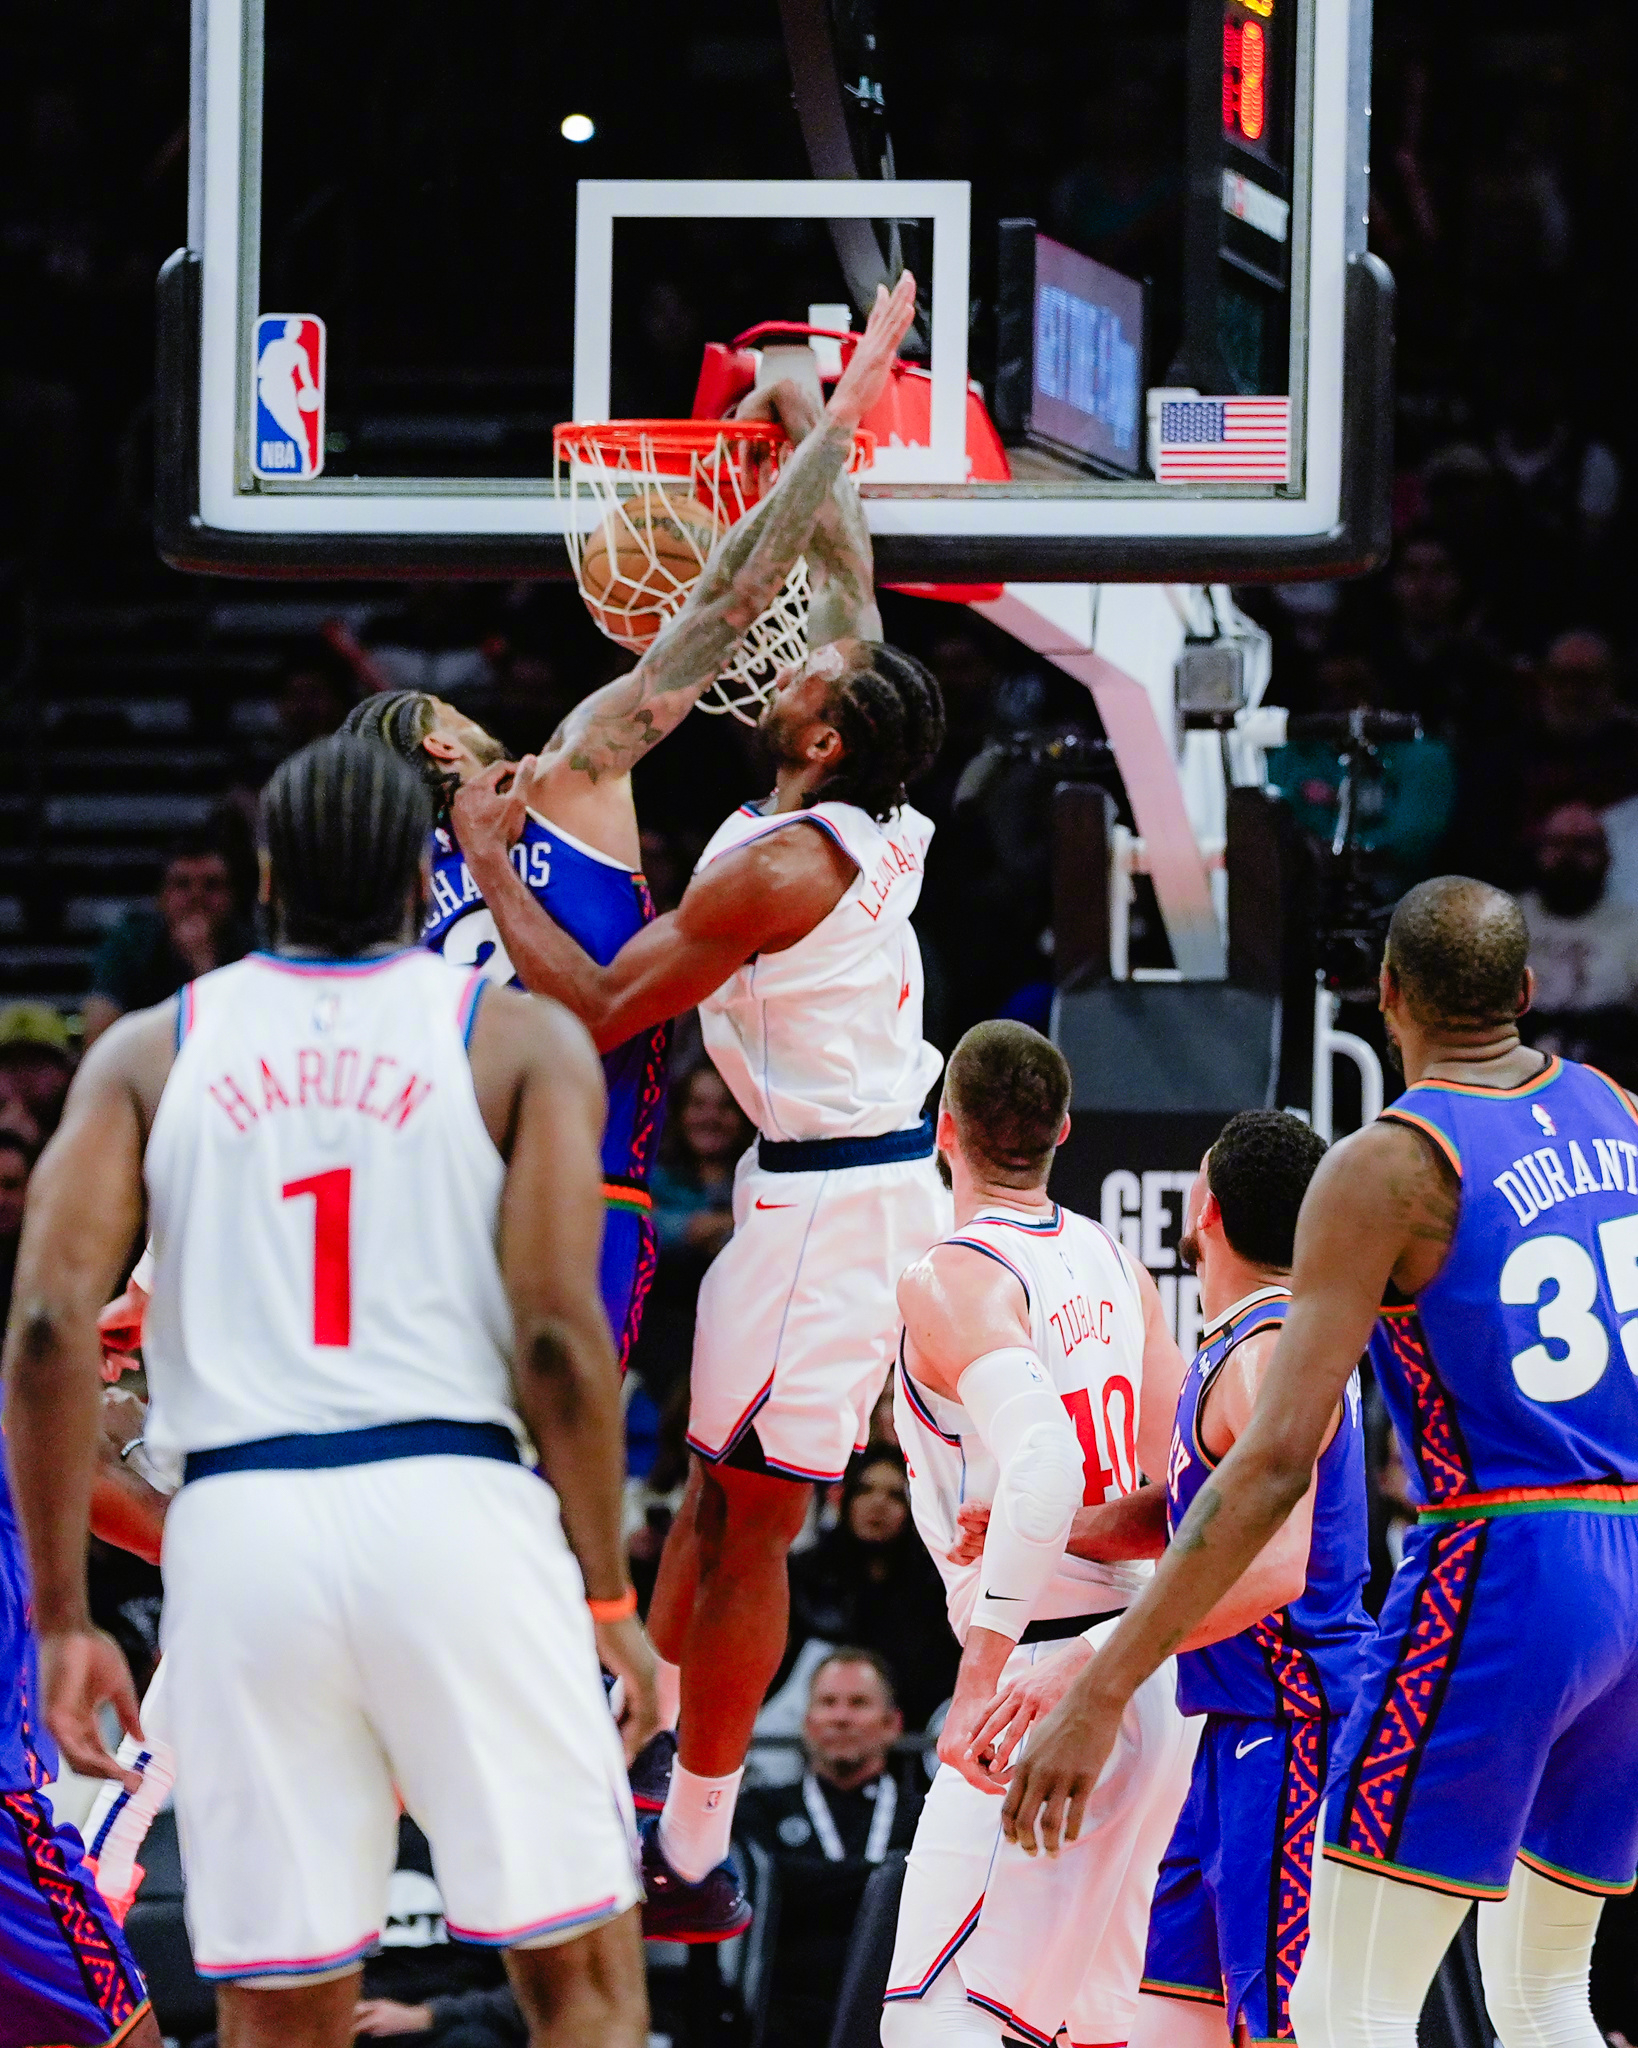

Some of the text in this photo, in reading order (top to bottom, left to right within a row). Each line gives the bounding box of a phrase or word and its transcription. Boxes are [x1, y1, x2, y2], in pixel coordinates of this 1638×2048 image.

[260, 439, 296, 469] NBA
[209, 1047, 433, 1133] HARDEN
[1493, 1138, 1638, 1227] DURANT
[281, 1167, 352, 1347] 1
[1050, 1295, 1113, 1358] ZUBAC
